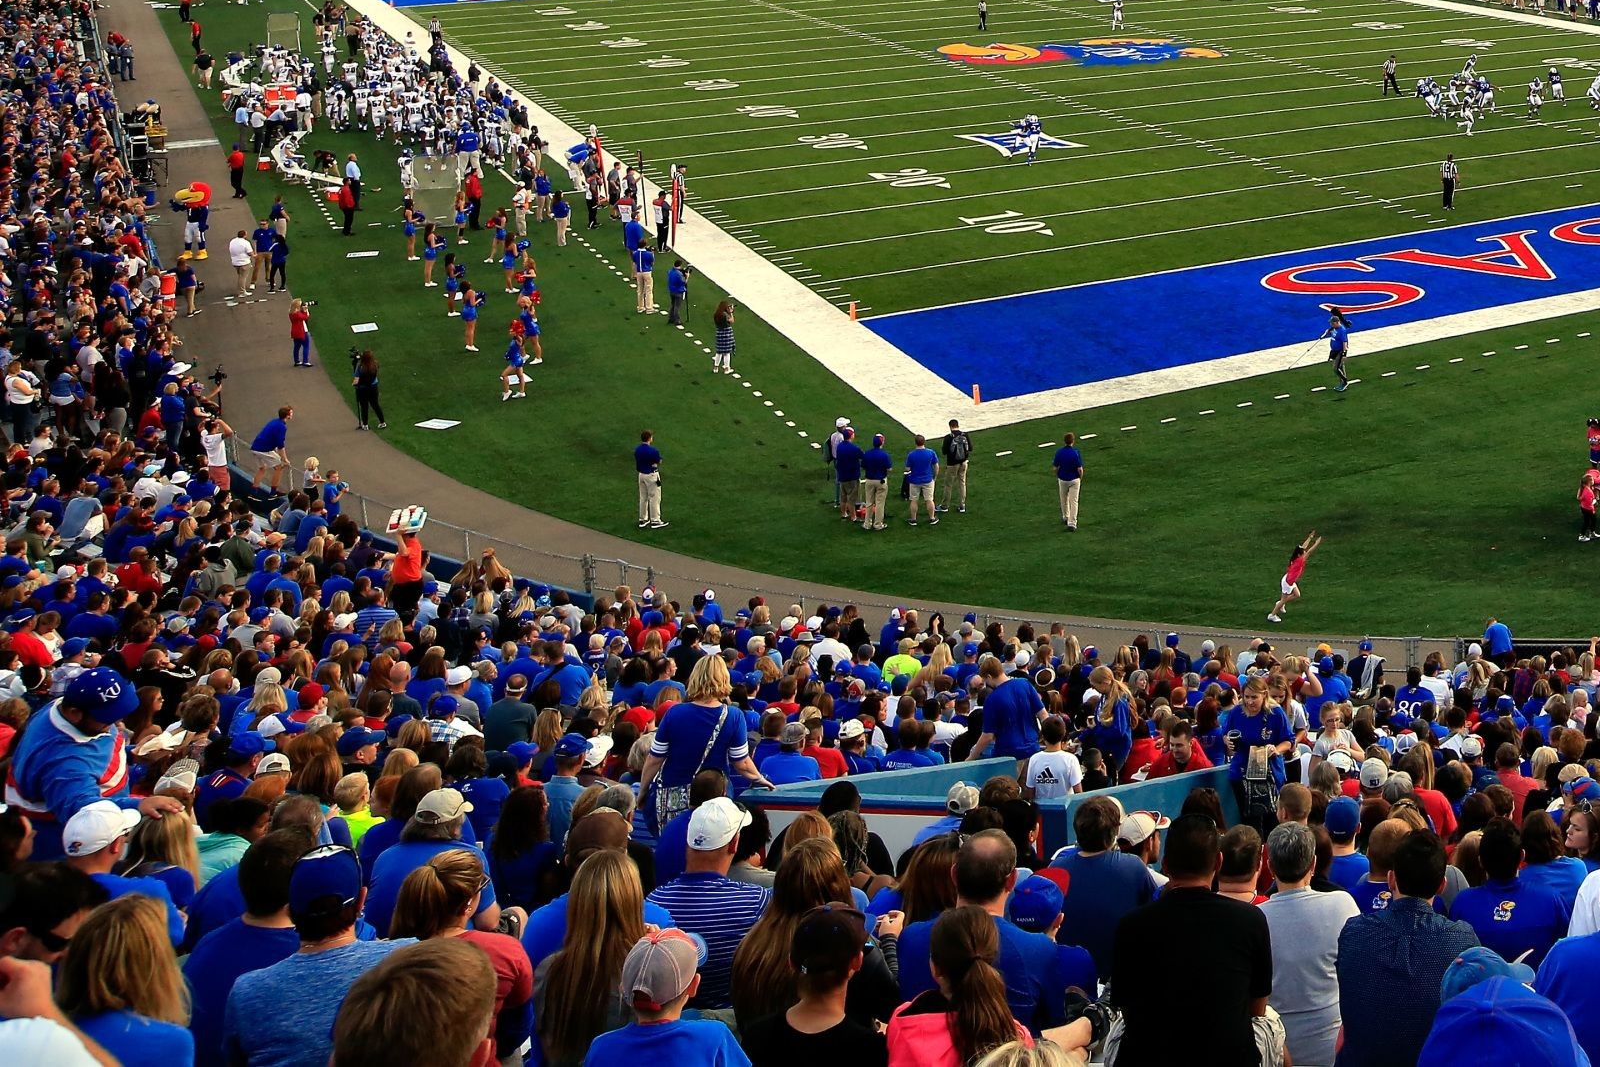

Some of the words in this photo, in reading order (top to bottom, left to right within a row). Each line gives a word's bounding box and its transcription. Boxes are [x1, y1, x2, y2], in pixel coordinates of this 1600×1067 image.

[736, 105, 798, 118] 40
[797, 132, 866, 150] 30
[867, 167, 948, 189] 20
[958, 209, 1048, 235] 10
[99, 682, 121, 703] KU
